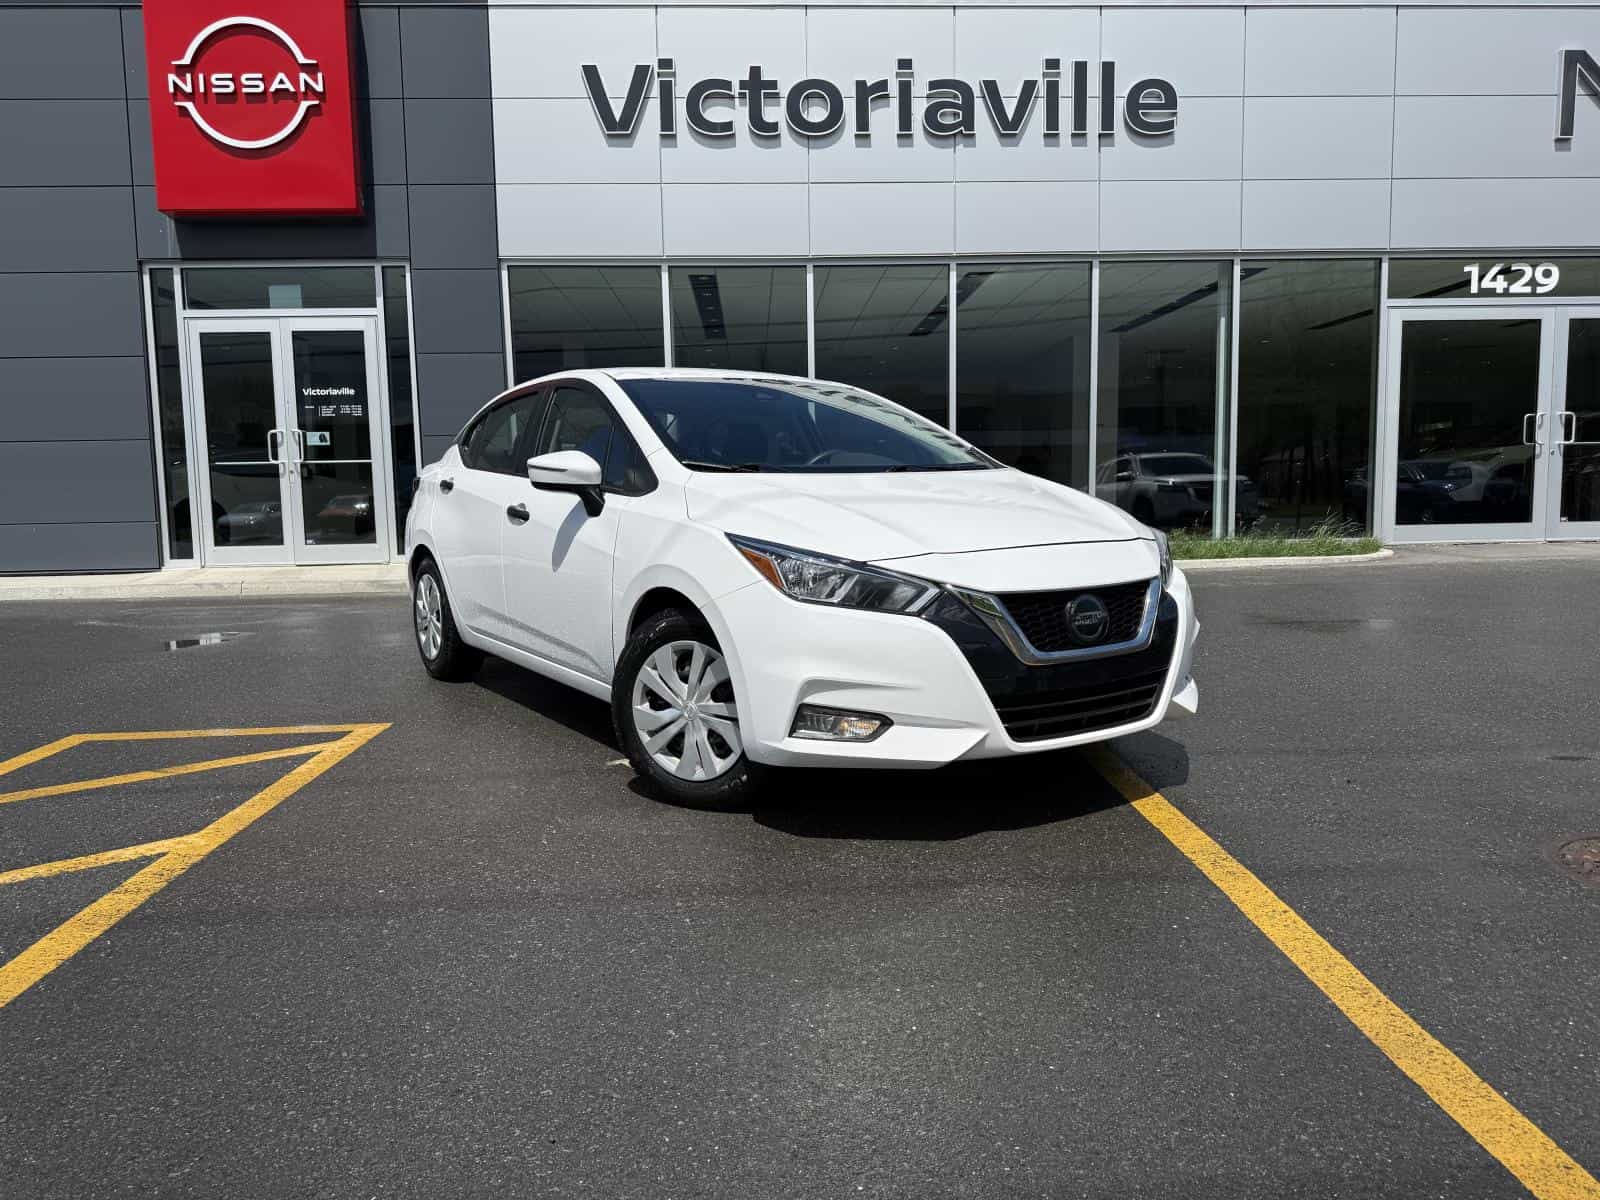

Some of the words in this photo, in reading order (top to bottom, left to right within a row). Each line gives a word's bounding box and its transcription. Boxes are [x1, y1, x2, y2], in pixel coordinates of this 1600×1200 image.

[167, 73, 324, 93] NISSAN
[581, 58, 1178, 136] Victoriaville
[1463, 263, 1560, 294] 1429
[302, 387, 355, 396] Victoriaville
